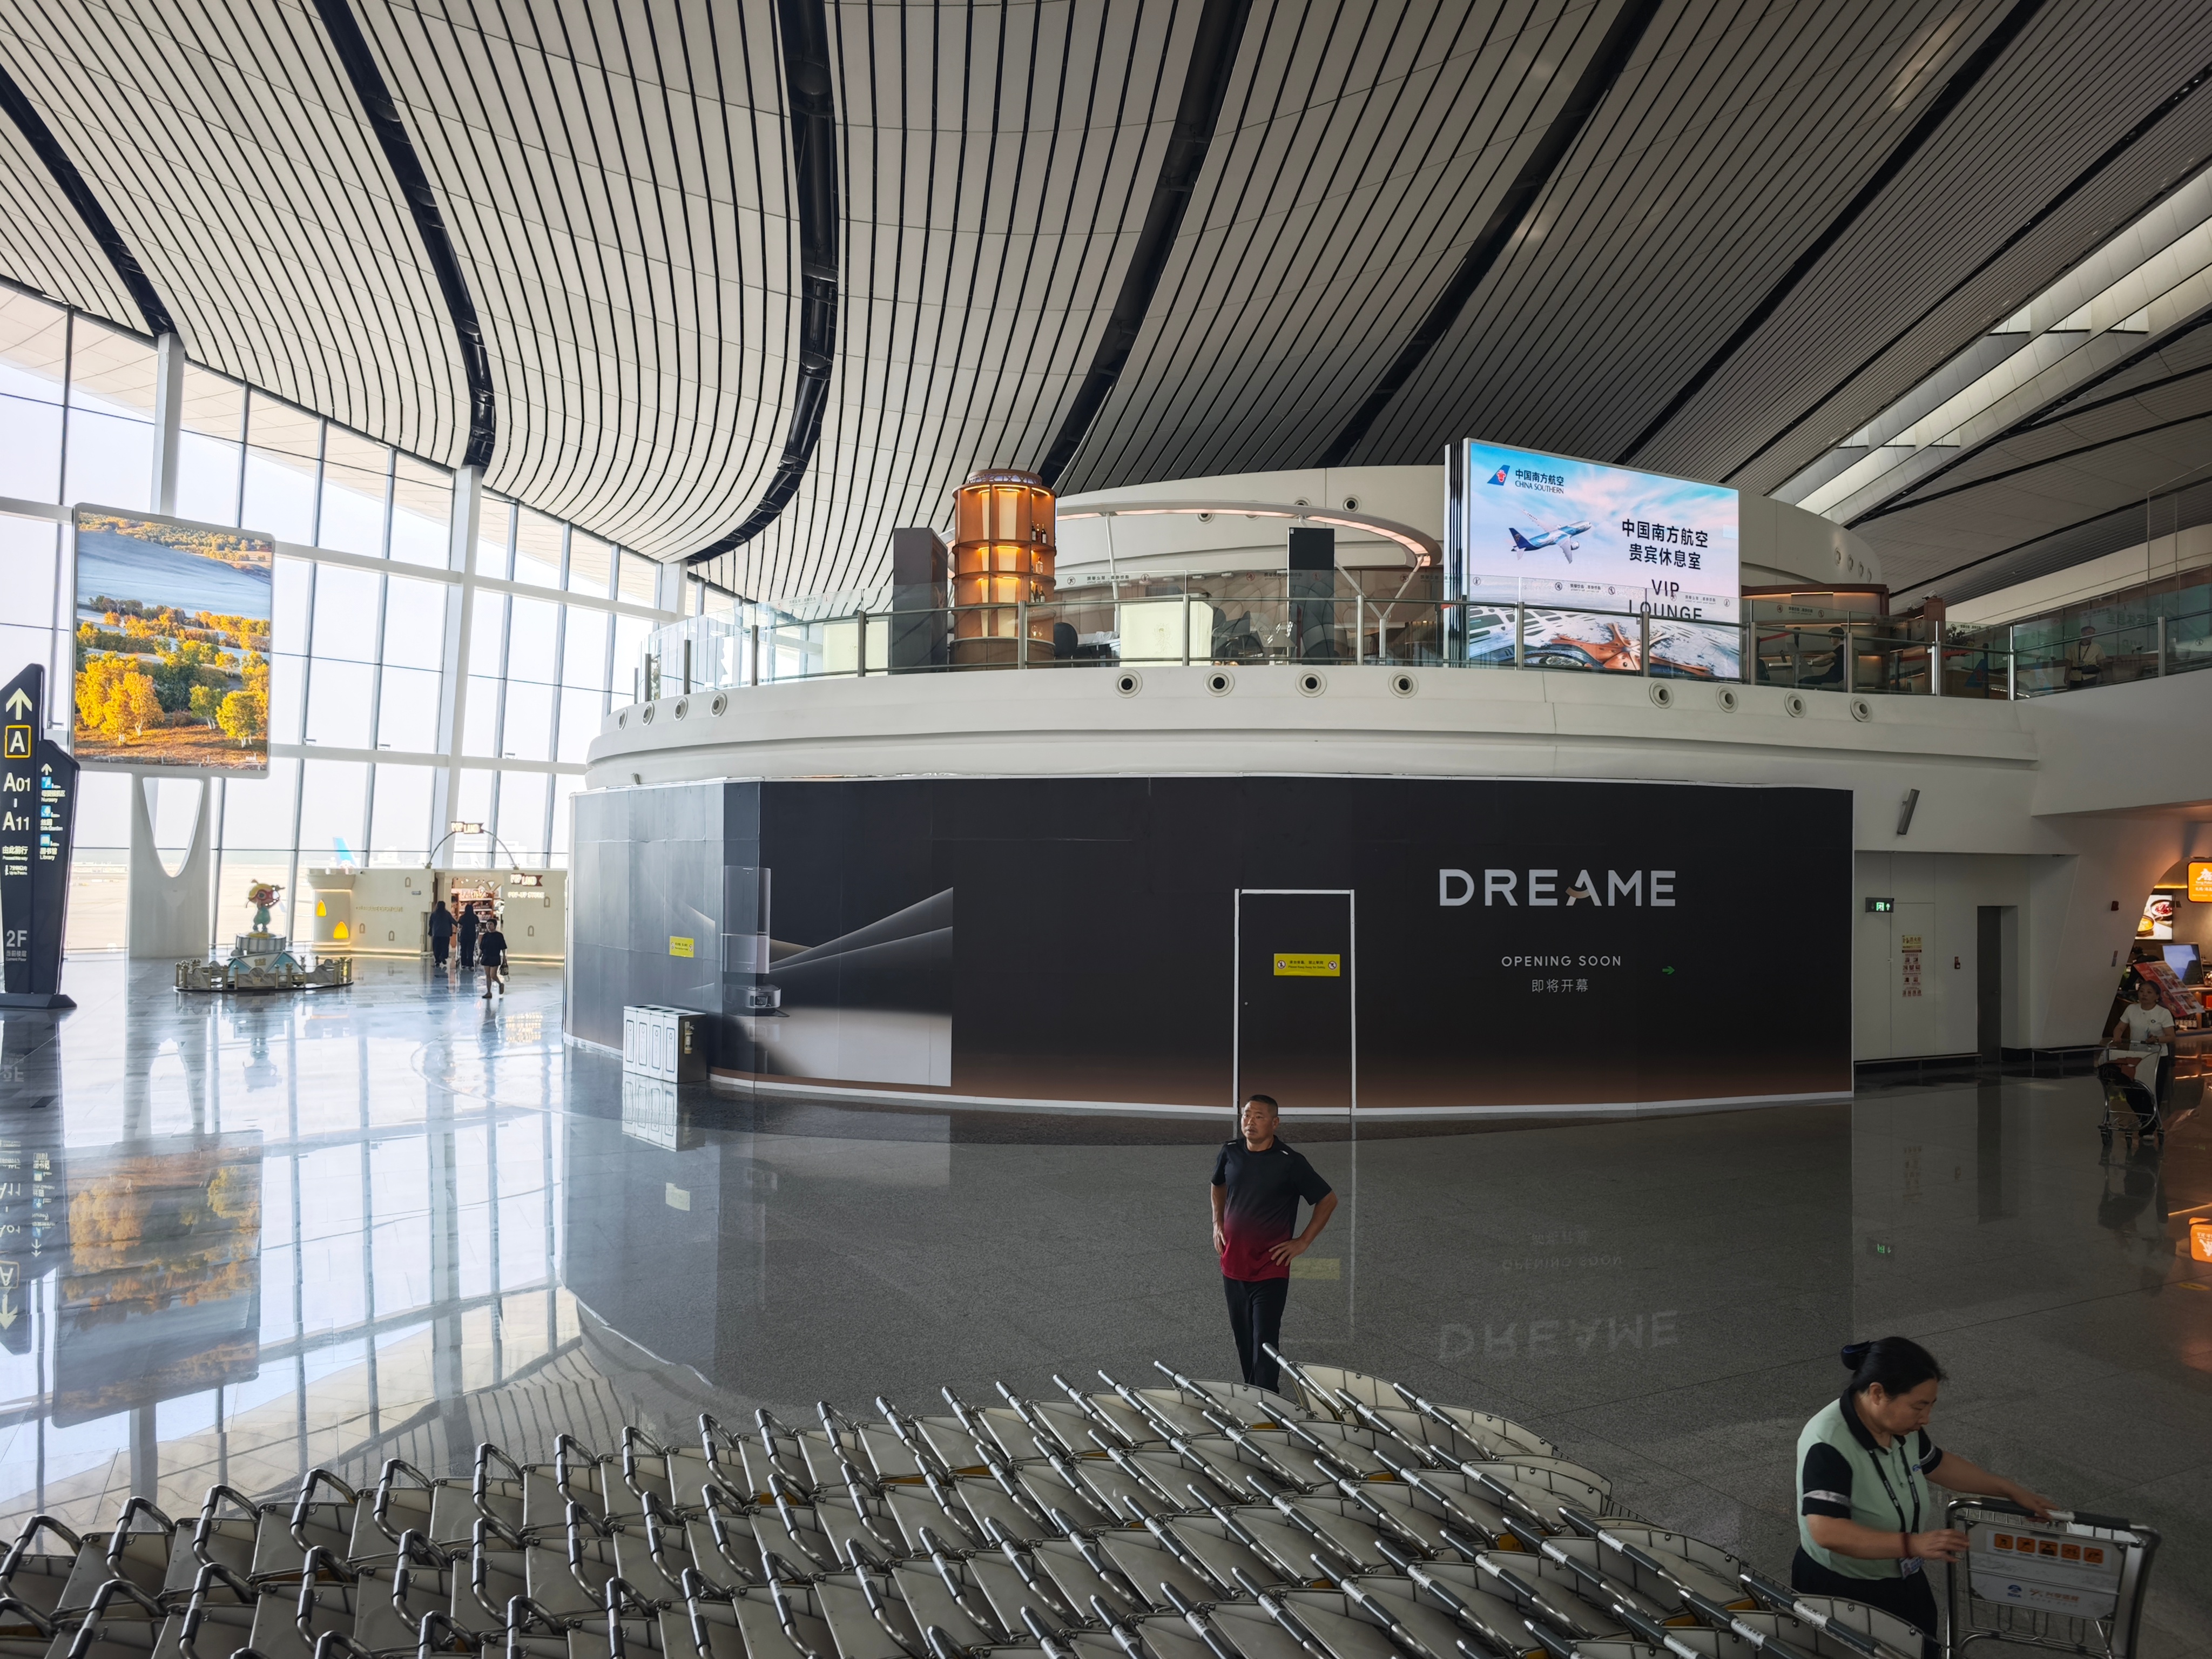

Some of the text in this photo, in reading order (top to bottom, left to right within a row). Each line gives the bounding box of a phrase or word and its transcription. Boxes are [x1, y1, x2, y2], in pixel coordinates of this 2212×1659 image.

[1515, 469, 1564, 487] 中国南方航空
[1515, 480, 1564, 494] CHINA SOUTHERN
[1622, 518, 1708, 548] 中国南方航空
[1629, 543, 1701, 570] 贵宾休息室
[1651, 579, 1680, 597] VIP
[1629, 599, 1702, 619] LOUNGE
[10, 731, 25, 753] A
[3, 772, 31, 792] A01
[2, 811, 29, 831] A11
[451, 822, 481, 834] POP LAND
[2, 846, 28, 855] 由此前行
[510, 874, 538, 886] POP LAND
[1439, 869, 1676, 907] DREAME
[6, 930, 28, 947] 2F
[1501, 956, 1621, 967] OPENING SOON
[1532, 979, 1589, 993] 即将开幕
